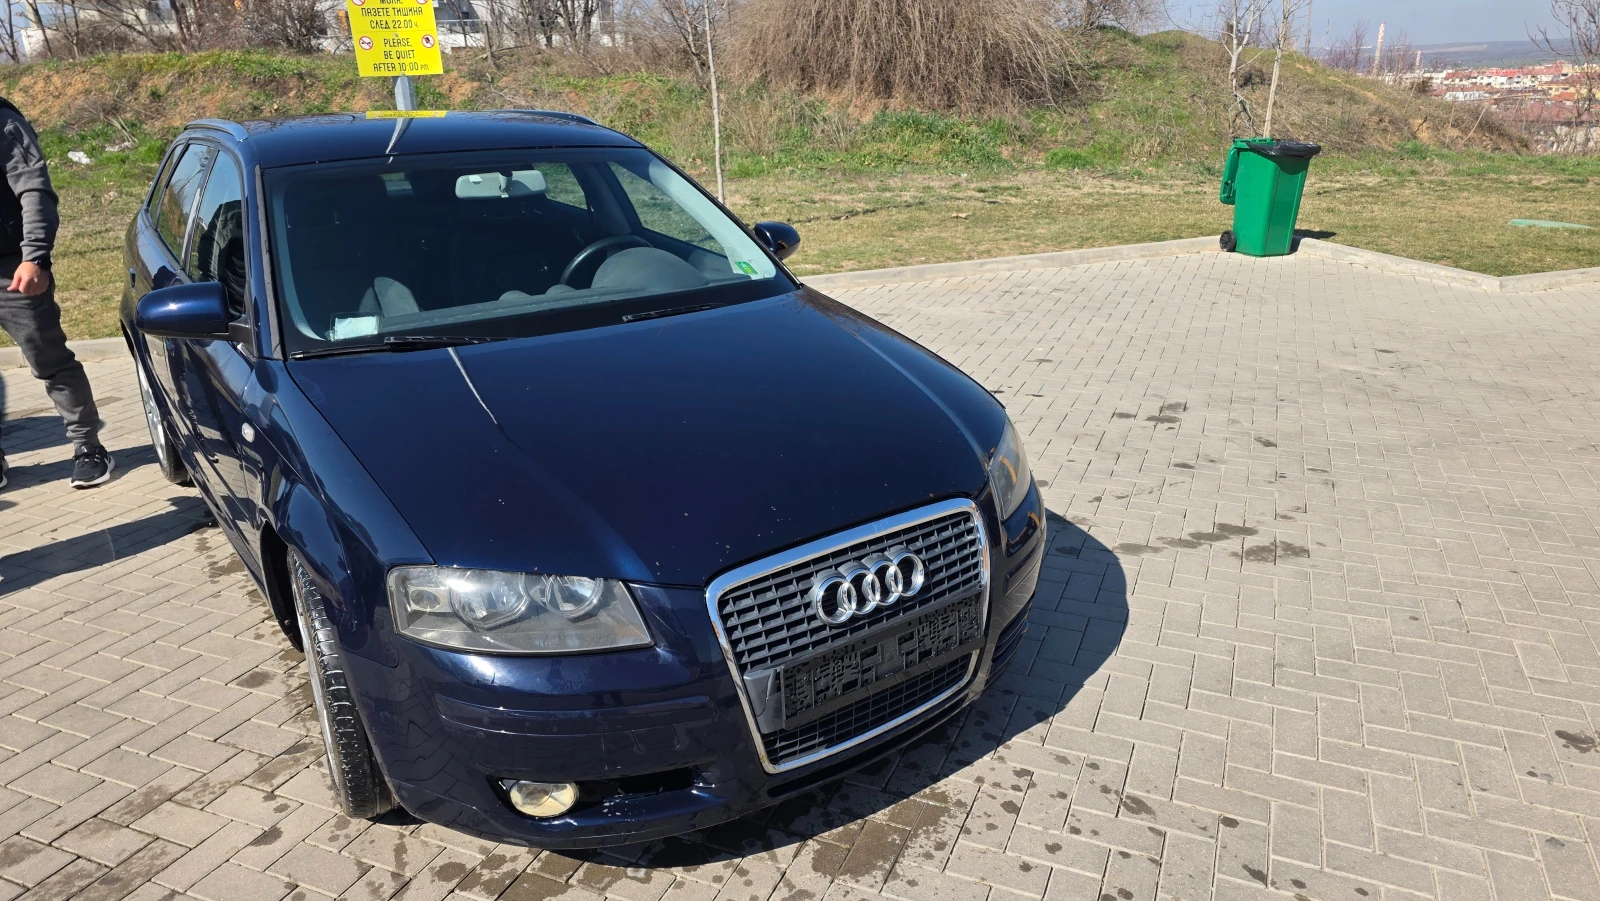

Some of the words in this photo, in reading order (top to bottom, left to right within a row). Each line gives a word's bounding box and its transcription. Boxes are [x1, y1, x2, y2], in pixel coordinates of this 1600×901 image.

[361, 7, 390, 16] ПАЗЕТЕ
[392, 6, 423, 16] ТИШИНА
[370, 20, 390, 29] СЛЕД
[392, 19, 413, 29] 22.00
[384, 50, 393, 60] BE
[396, 49, 415, 60] QUIET
[373, 63, 396, 72] AFTER
[398, 61, 419, 71] 10:00
